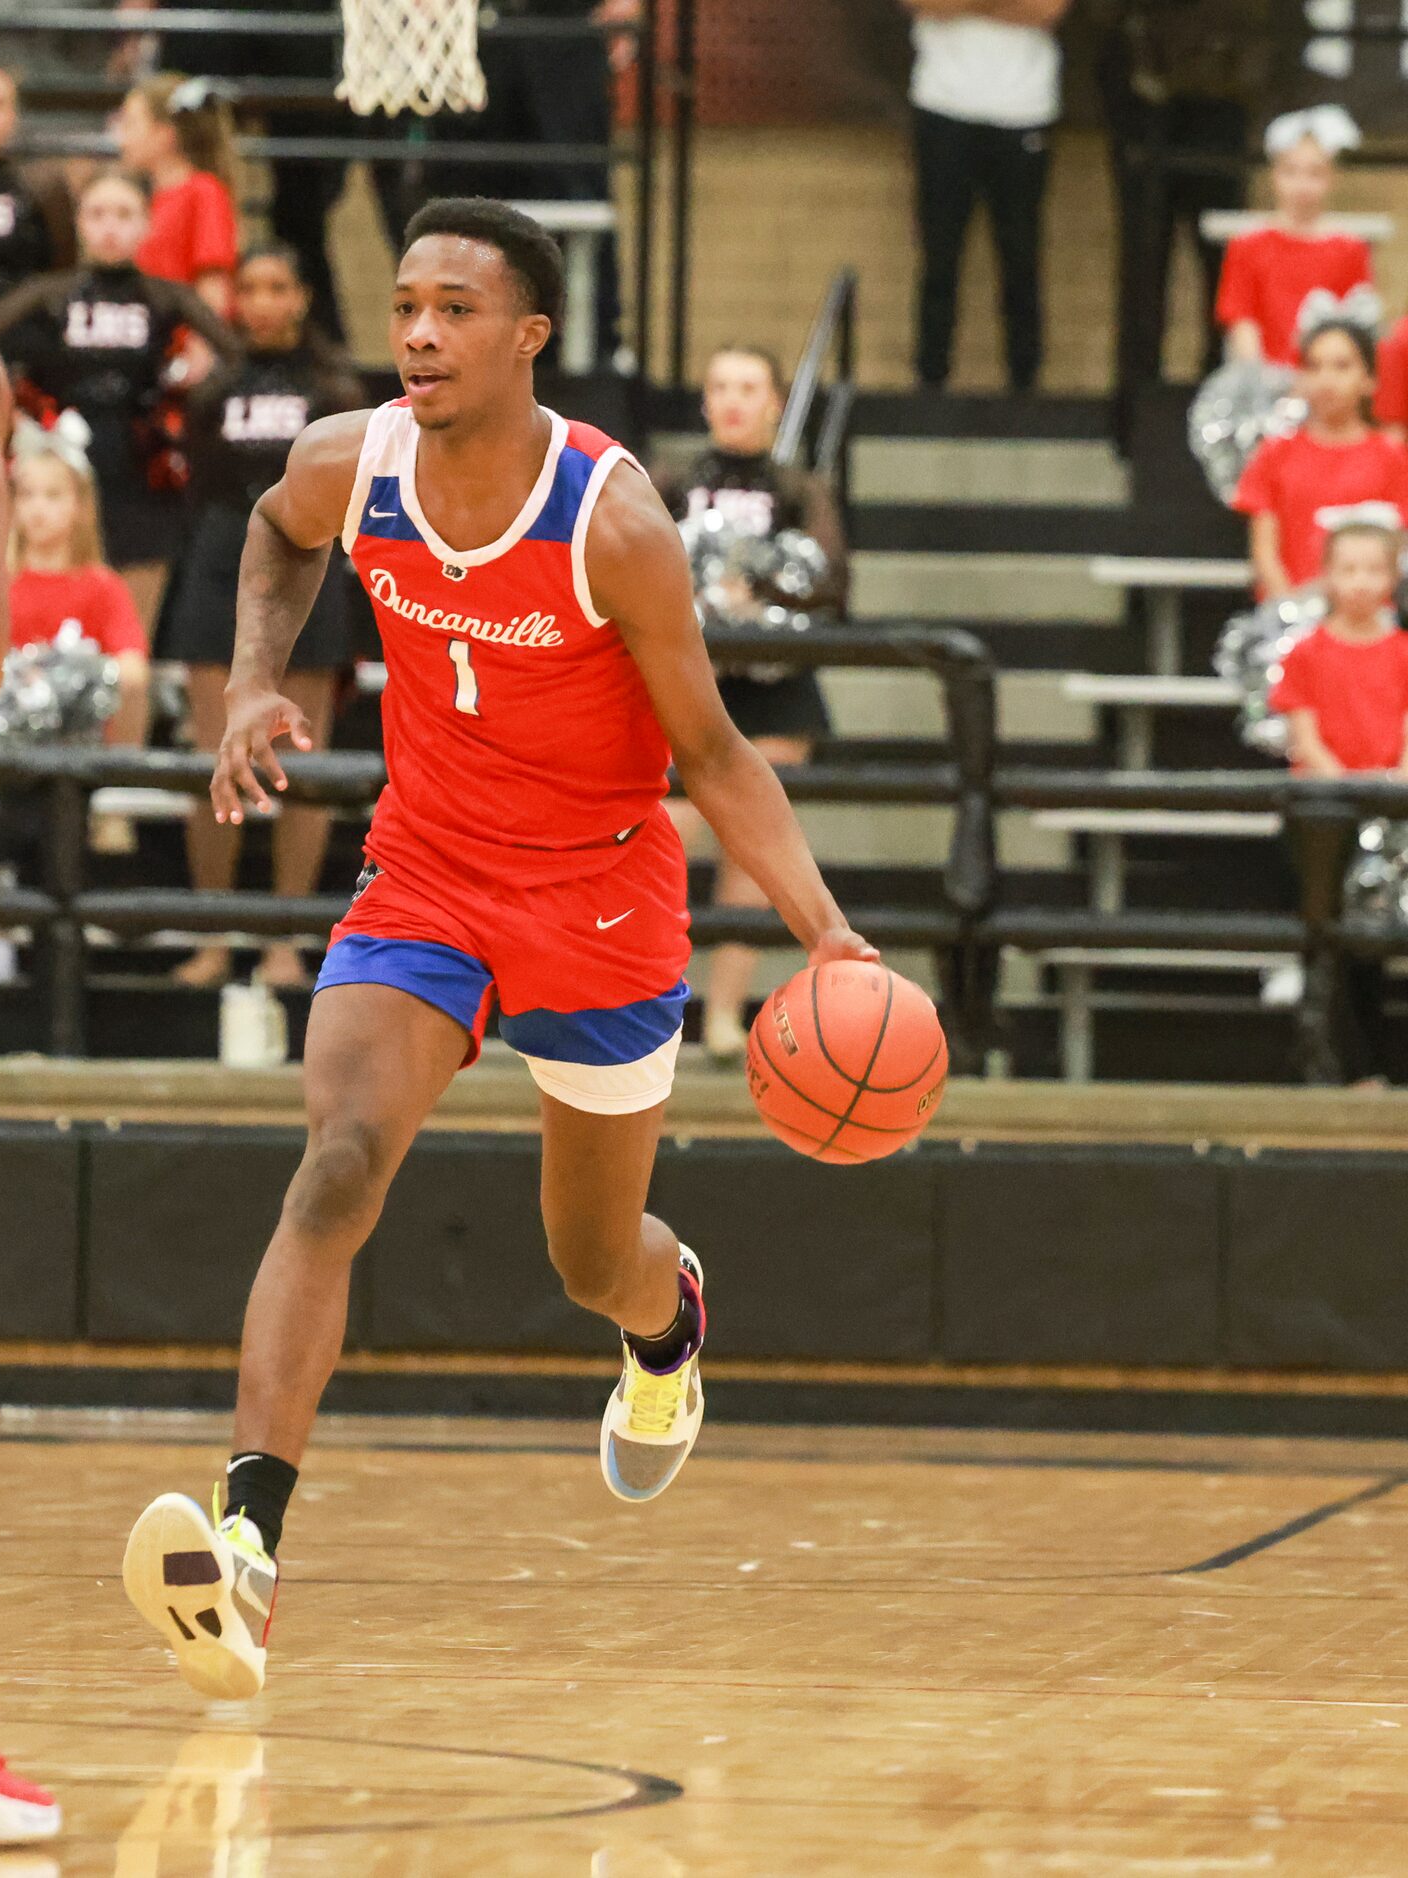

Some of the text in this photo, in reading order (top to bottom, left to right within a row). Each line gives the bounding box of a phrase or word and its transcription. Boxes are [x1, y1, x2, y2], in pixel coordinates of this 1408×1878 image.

[66, 301, 150, 348] LHS
[222, 394, 309, 441] LHS
[369, 568, 564, 648] Duncanville
[448, 637, 480, 717] 1
